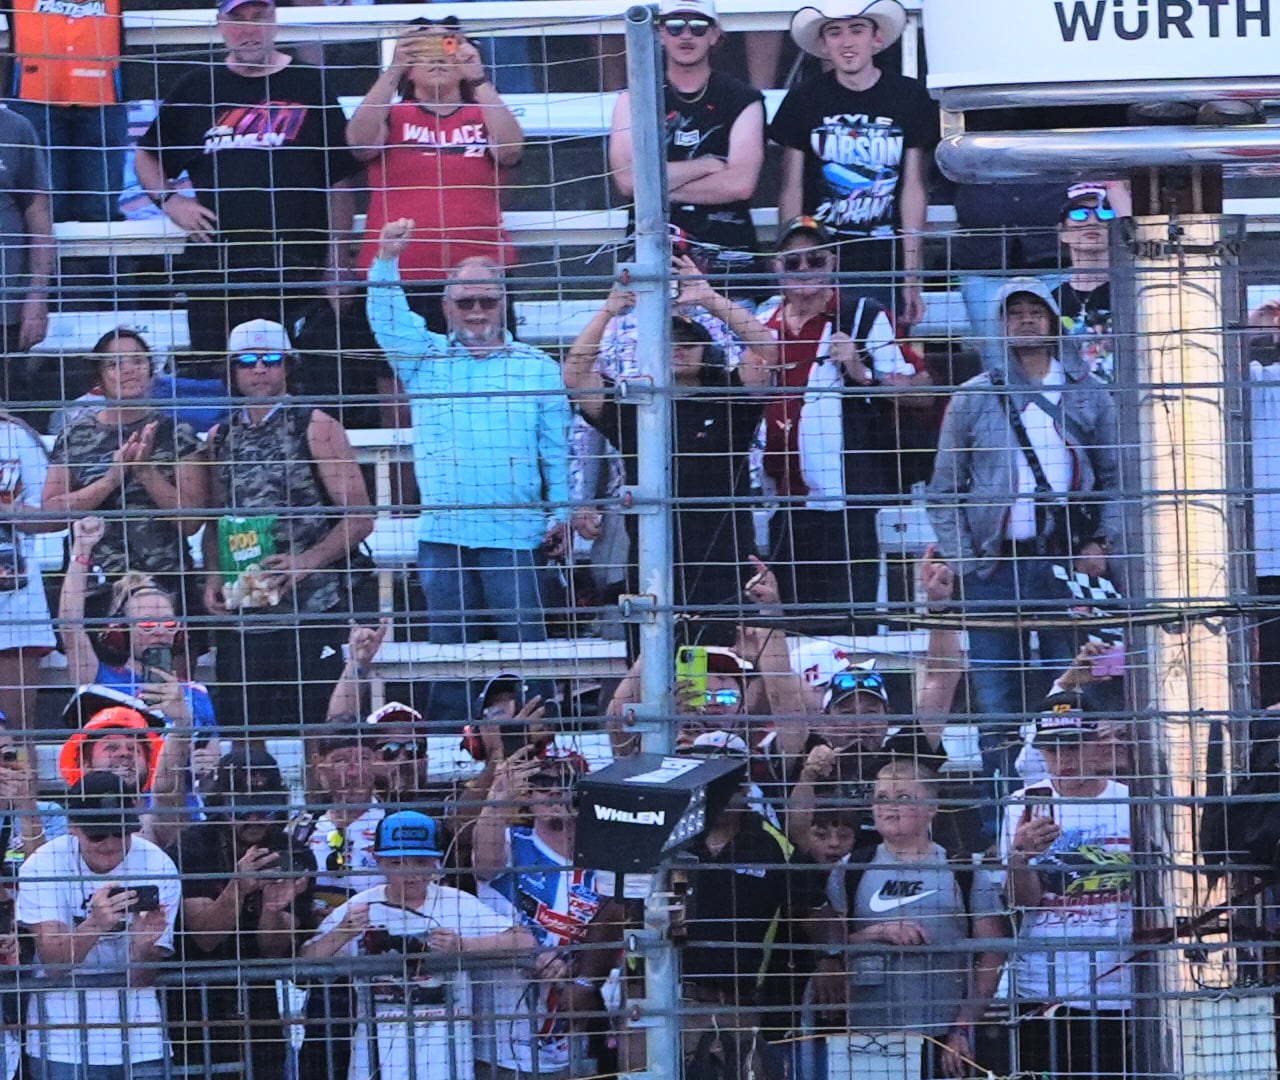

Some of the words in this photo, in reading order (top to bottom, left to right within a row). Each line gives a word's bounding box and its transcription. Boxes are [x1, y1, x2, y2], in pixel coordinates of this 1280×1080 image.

[1054, 0, 1270, 41] WÜRTH
[402, 122, 488, 145] WALLACE
[810, 132, 904, 166] LARSON
[593, 804, 665, 826] WHELEN
[880, 879, 925, 897] NIKE
